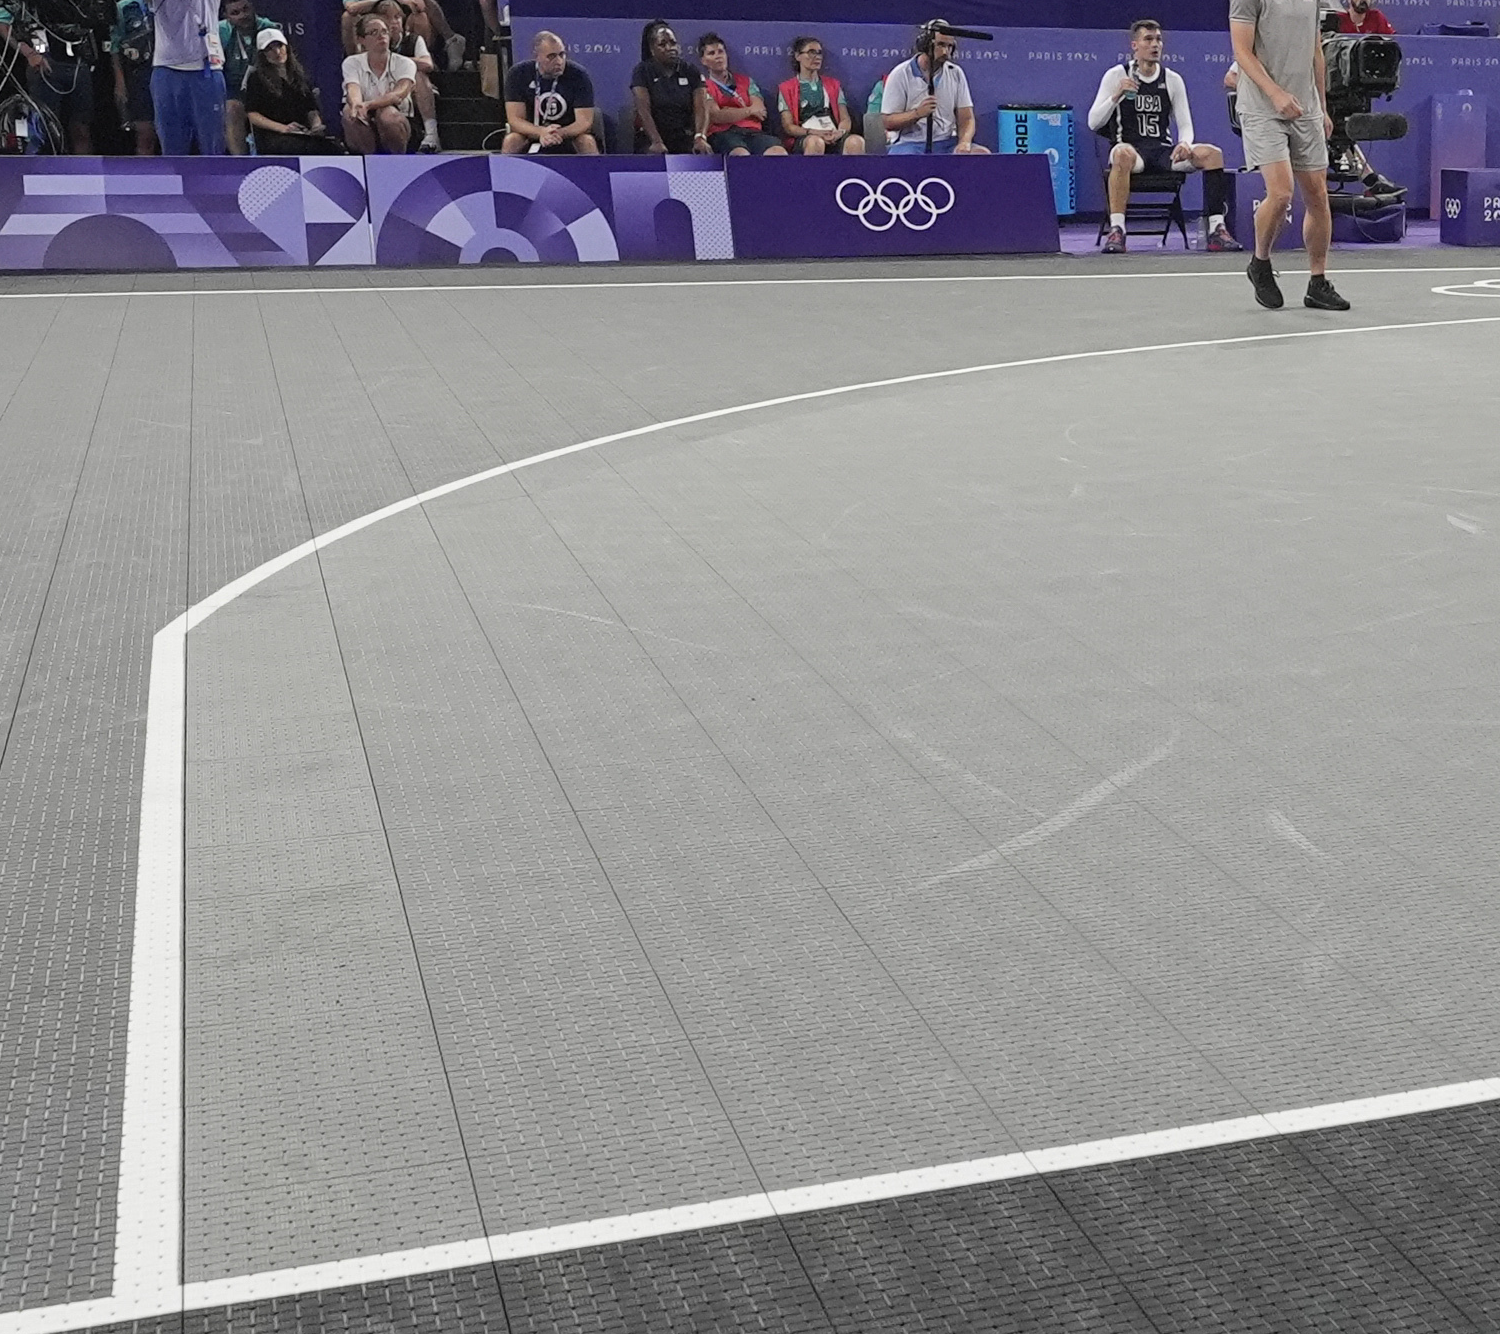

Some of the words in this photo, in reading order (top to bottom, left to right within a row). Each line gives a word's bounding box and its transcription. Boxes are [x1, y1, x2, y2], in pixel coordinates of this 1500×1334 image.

[744, 46, 783, 56] PARIS
[841, 47, 878, 58] PARIS
[976, 51, 1008, 60] 2024
[1028, 51, 1061, 61] PARIS
[1066, 51, 1098, 61] 2024
[1162, 53, 1185, 62] 024
[1405, 57, 1434, 66] 2024
[1451, 57, 1481, 67] PARIS
[1136, 94, 1162, 113] USA
[1136, 114, 1161, 138] 15
